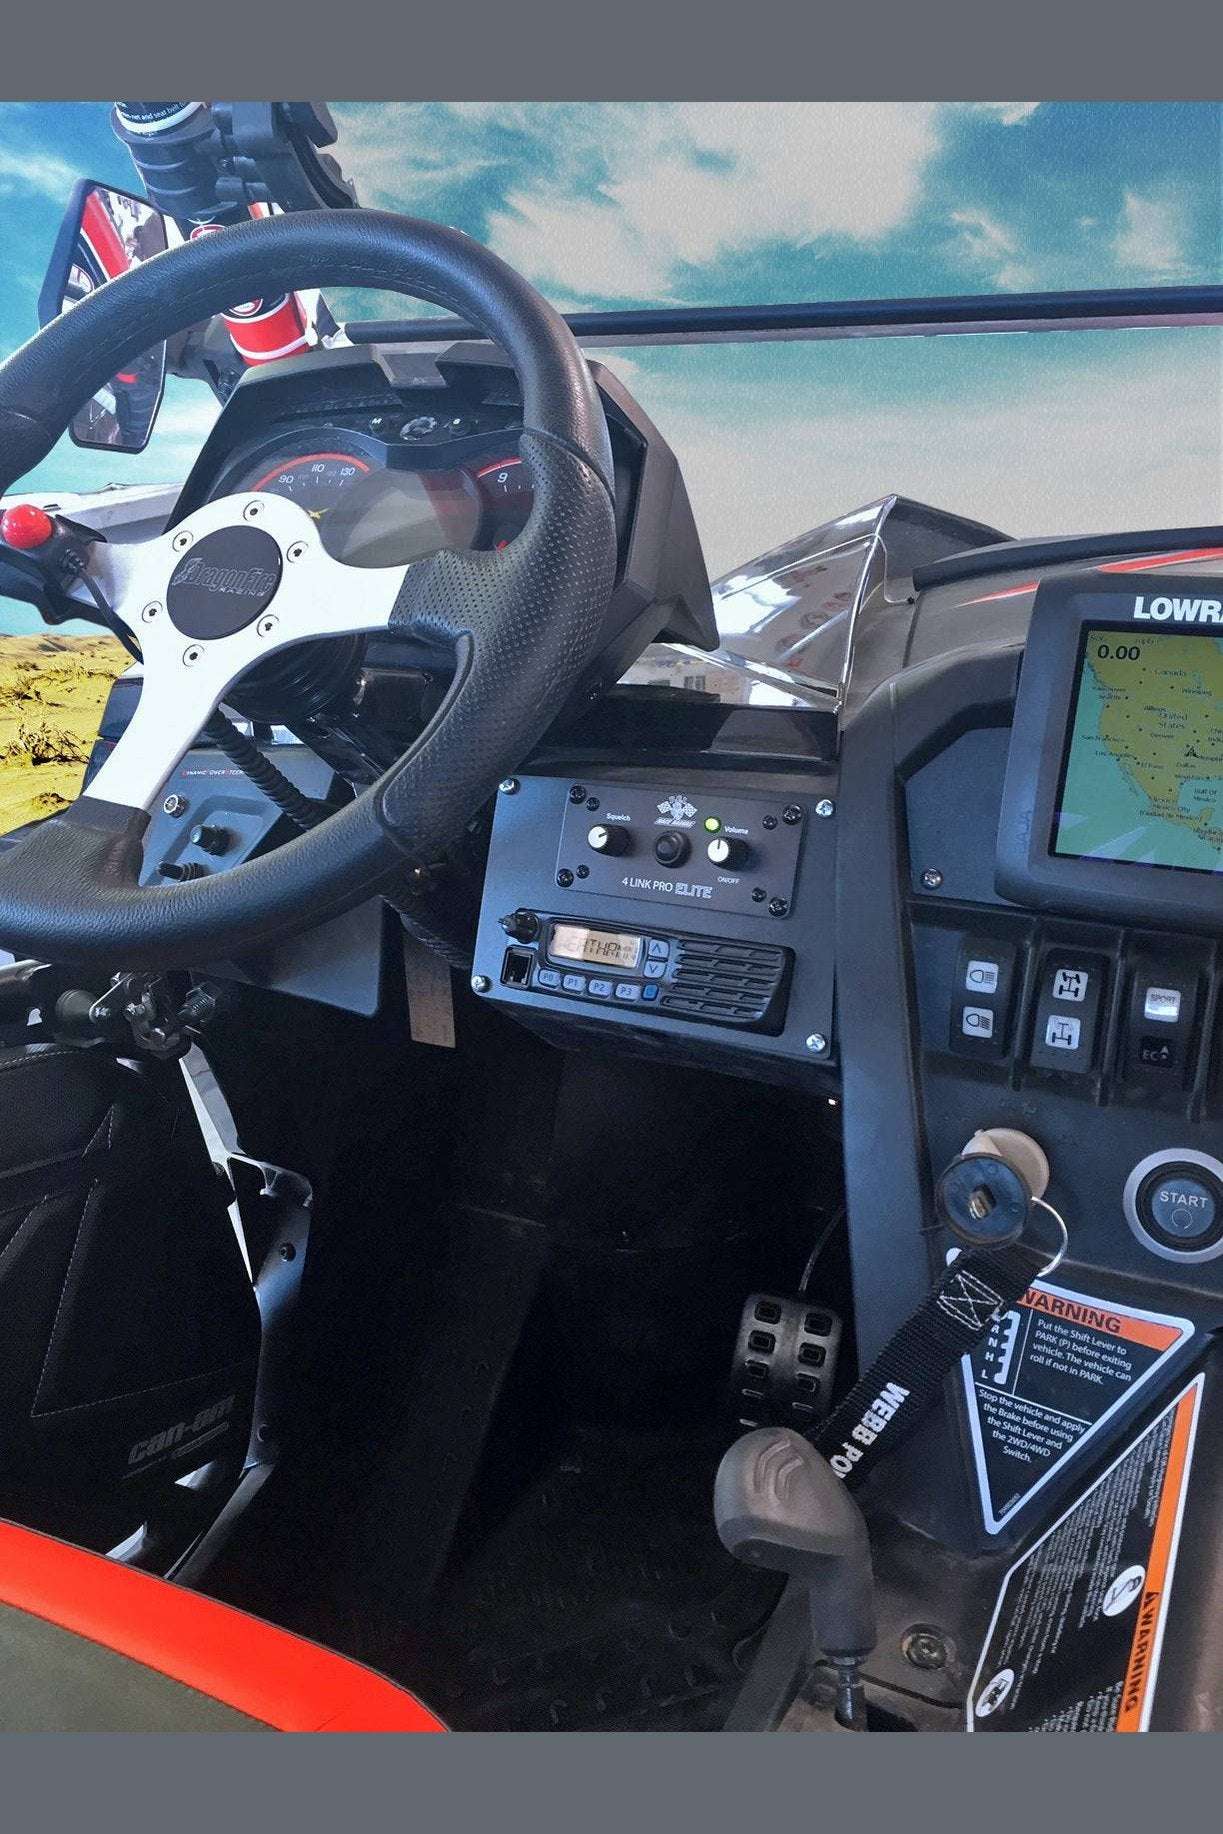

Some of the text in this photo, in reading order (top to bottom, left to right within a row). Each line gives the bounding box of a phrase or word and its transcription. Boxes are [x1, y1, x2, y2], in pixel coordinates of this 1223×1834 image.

[278, 474, 294, 485] 90
[340, 467, 356, 476] 130
[497, 472, 508, 483] 9
[1134, 596, 1223, 623] LOWR
[1097, 644, 1141, 661] 0.00
[606, 812, 631, 822] Squelch
[724, 825, 750, 835] Volume
[621, 877, 713, 900] 4 LINK PRO ELITE
[1160, 1190, 1209, 1209] START
[988, 1338, 998, 1348] N
[1038, 1319, 1127, 1355] Put the Shift Lever to
[985, 1351, 995, 1362] H
[1032, 1342, 1132, 1382] vehicle. The vehicle can
[1035, 1330, 1132, 1371] PARK (P) before exiting
[981, 1369, 989, 1379] L
[1030, 1353, 1104, 1385] roll if not in PARK.
[851, 1382, 910, 1446] WEBB
[978, 1389, 1086, 1434] Stop the vehicle and apply
[983, 1403, 1074, 1443] the Brake before using
[987, 1416, 1063, 1450] the Shift Lever and
[992, 1430, 1051, 1457] the 2WD/4WD
[1002, 1445, 1032, 1463] Switch.
[1126, 1608, 1155, 1713] WARNING
